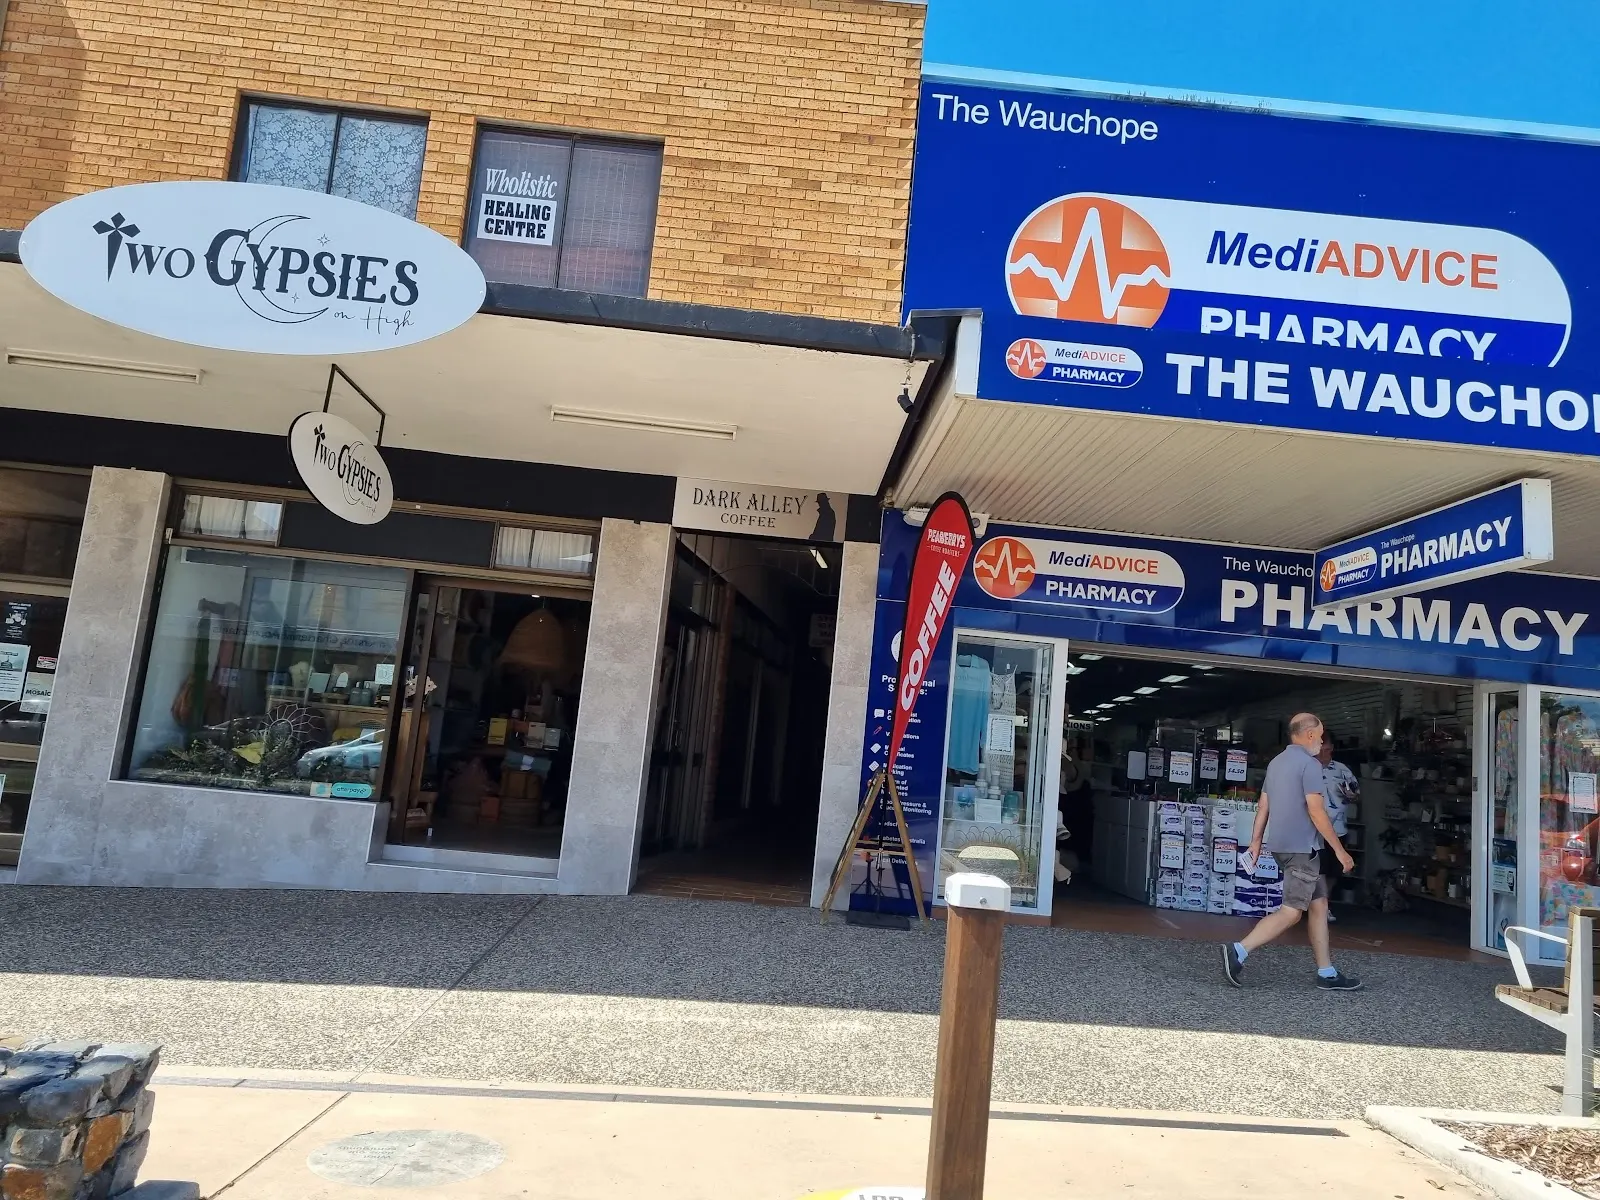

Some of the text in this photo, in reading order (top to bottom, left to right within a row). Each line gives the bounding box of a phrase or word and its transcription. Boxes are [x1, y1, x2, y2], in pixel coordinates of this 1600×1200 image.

[931, 93, 1159, 144] The Wauchope
[485, 167, 558, 199] Wholistic
[483, 199, 552, 222] HEALING
[484, 217, 547, 240] CENTRE
[204, 227, 420, 307] GYPSIES
[1205, 229, 1499, 291] MediADVICE
[333, 305, 416, 336] on High
[1054, 347, 1127, 364] MediADVICE
[1052, 366, 1125, 384] PHARMACY
[1165, 350, 1600, 434] THE WAUCHO
[337, 444, 382, 502] GYPSIES
[692, 487, 809, 516] DARK ALLEY
[720, 512, 777, 529] COFFEE
[1380, 533, 1416, 550] The Wauchope
[1380, 516, 1513, 579] PHARMACY
[1048, 550, 1159, 575] MediADVICE
[1223, 556, 1314, 578] The Waucho
[1338, 551, 1371, 568] MediADVICE
[1337, 568, 1370, 585] PHARMACY
[1045, 579, 1157, 606] PHARMACY
[1220, 578, 1590, 656] PHARMACY
[901, 559, 957, 711] COFFEE
[902, 806, 932, 816] Monitoring
